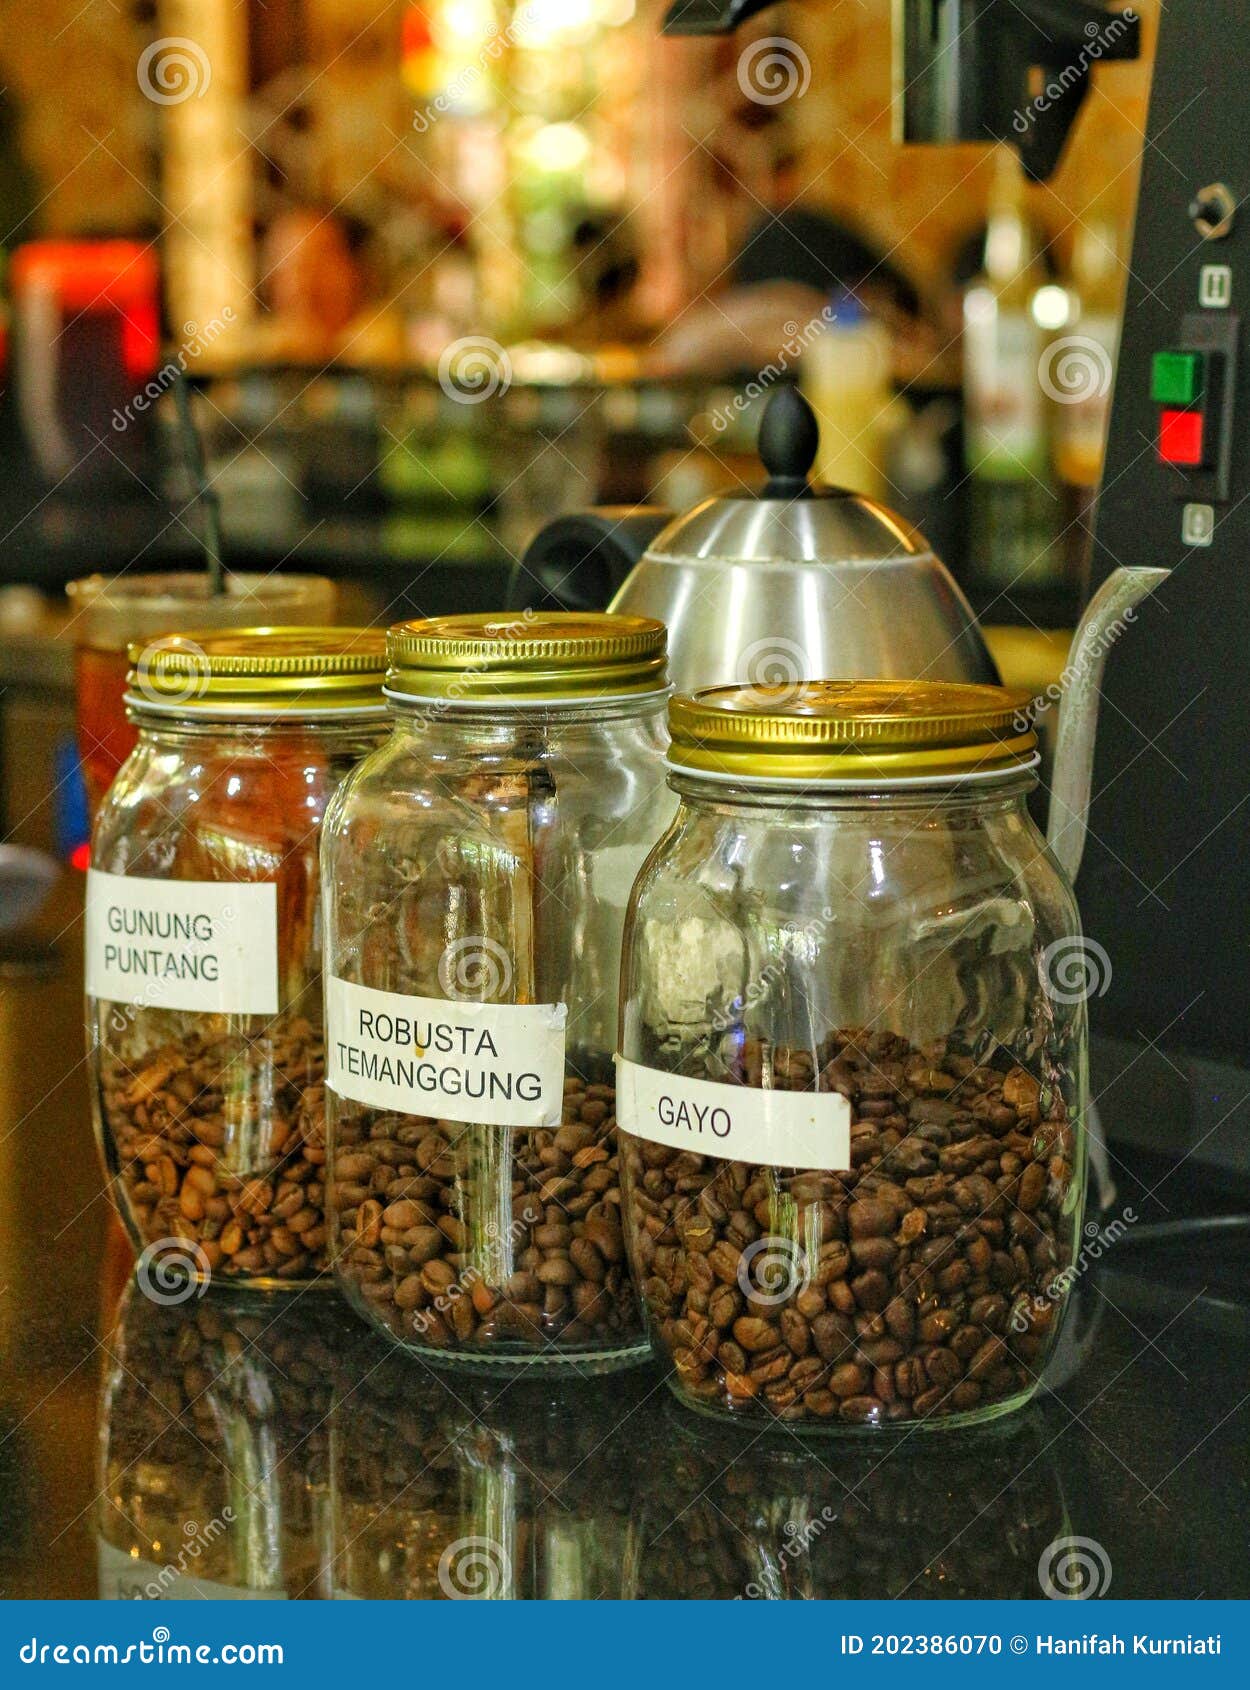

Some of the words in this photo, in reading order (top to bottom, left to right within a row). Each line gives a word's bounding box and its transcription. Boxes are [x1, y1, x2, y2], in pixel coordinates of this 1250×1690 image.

[107, 906, 213, 942] GUNUNG
[104, 945, 218, 982] PUNTANG
[359, 1008, 499, 1058] ROBUSTA
[336, 1041, 542, 1102] TEMANGGUNG
[658, 1096, 731, 1138] GAYO
